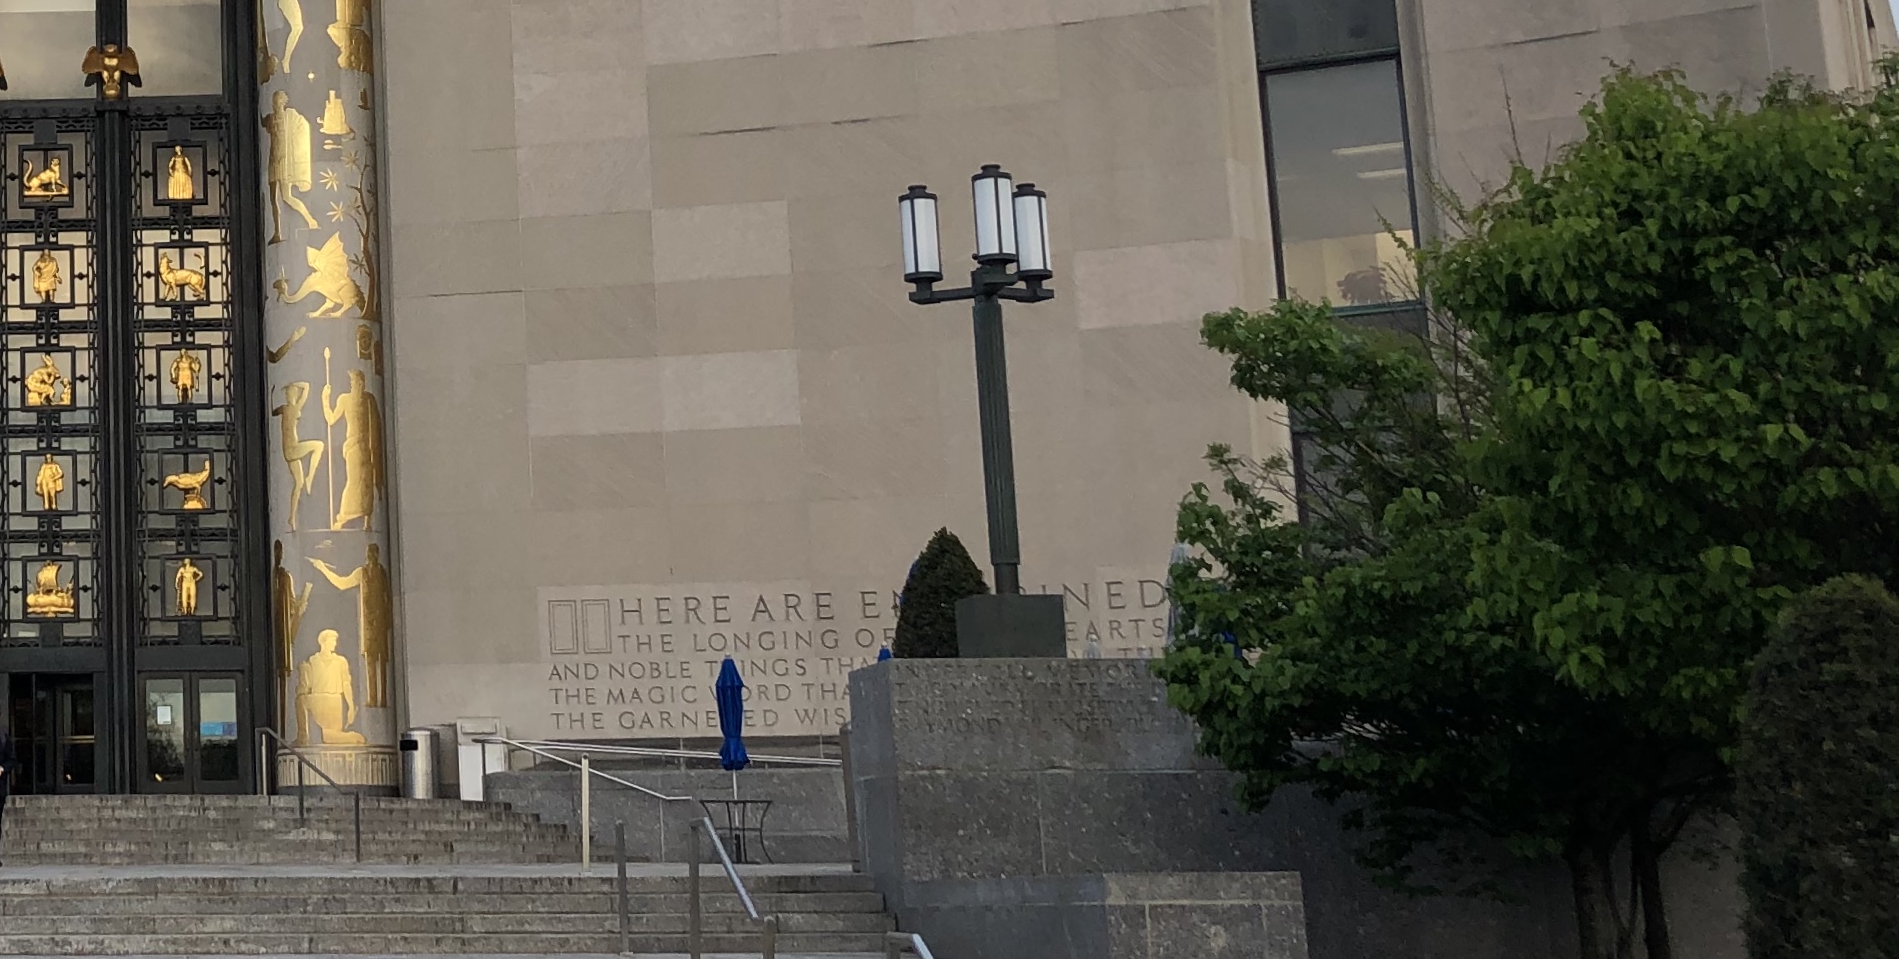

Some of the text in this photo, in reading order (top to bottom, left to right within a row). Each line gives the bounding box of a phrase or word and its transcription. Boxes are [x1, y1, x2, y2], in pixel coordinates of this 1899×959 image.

[618, 595, 732, 626] HERE
[751, 592, 835, 622] ARE
[617, 617, 1166, 654] THE LONGING OF EARTS
[548, 662, 600, 681] AND
[608, 661, 693, 681] NOBLE
[704, 658, 807, 677] TINGS
[819, 656, 879, 675] THA
[549, 687, 597, 706] THE
[605, 685, 698, 705] MAGIC
[800, 682, 851, 701] THA
[550, 712, 605, 730] THE
[618, 709, 779, 730] GARNEED
